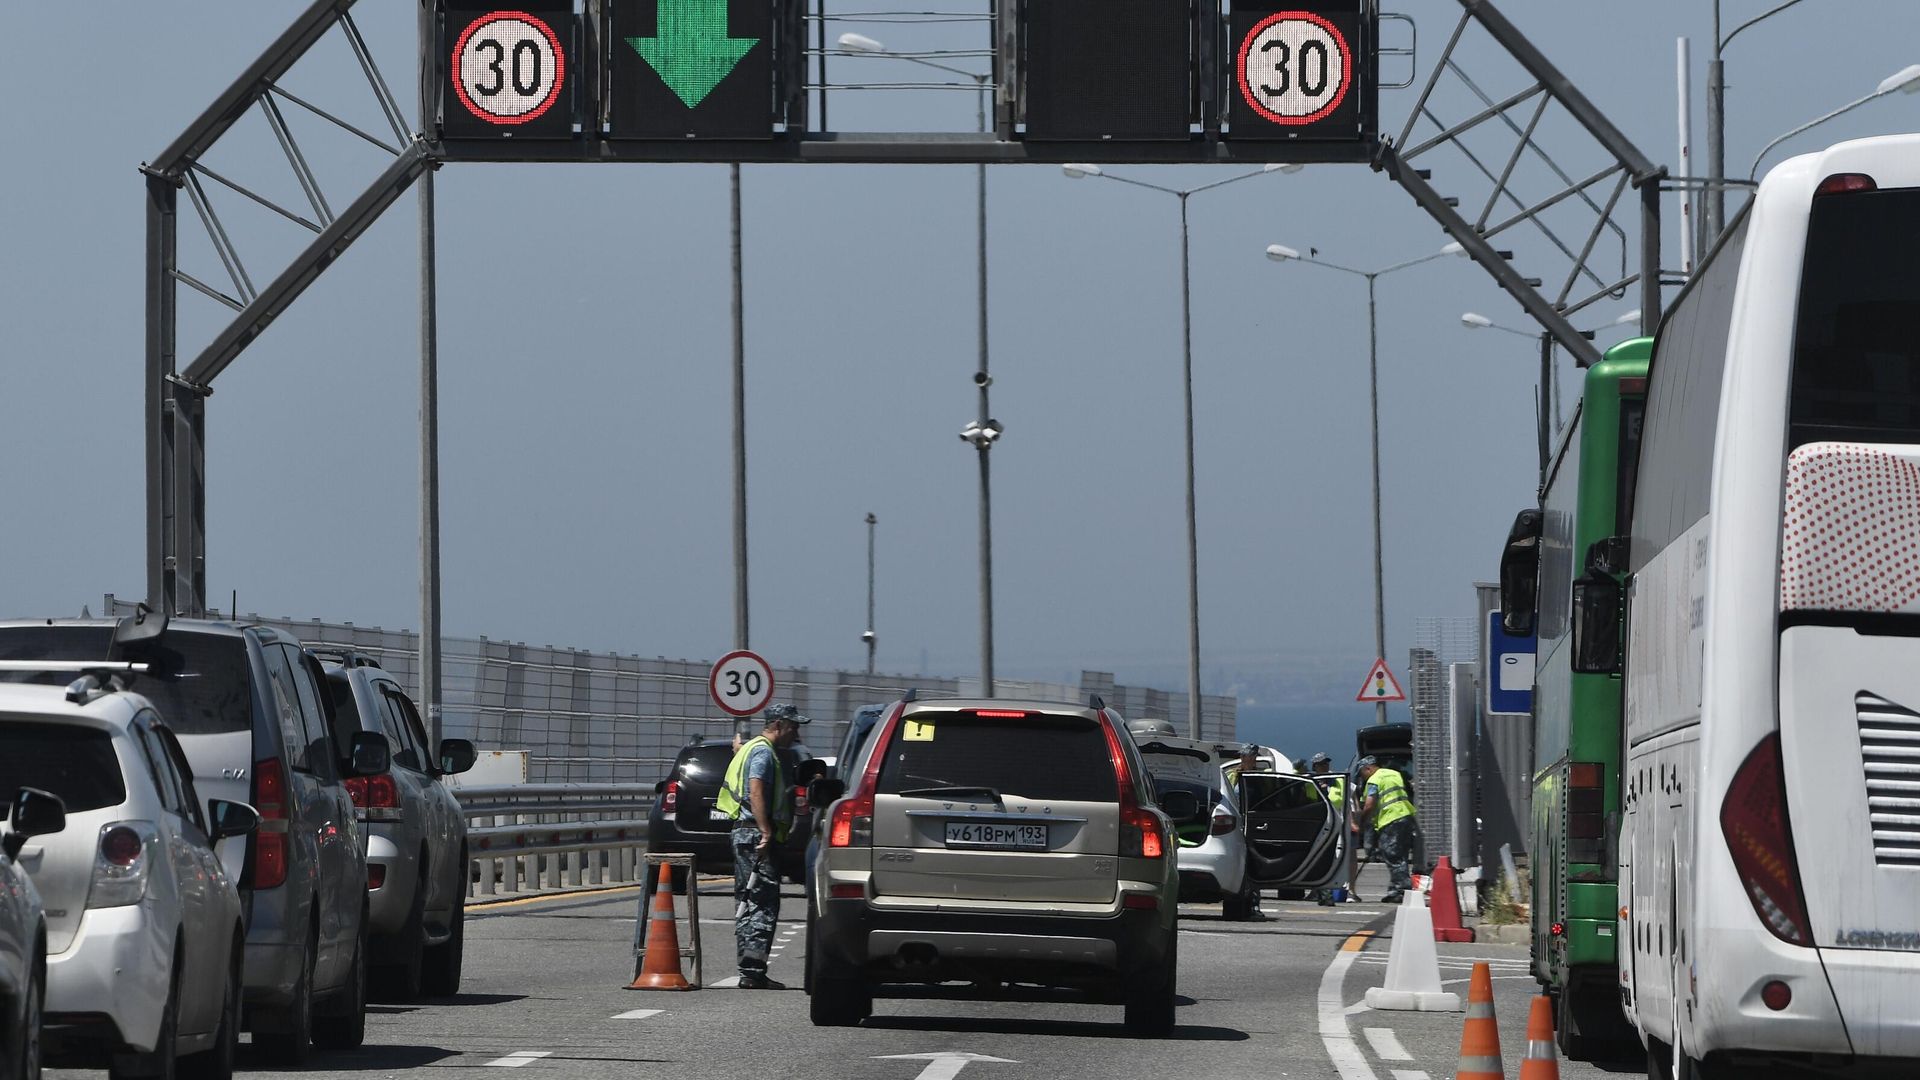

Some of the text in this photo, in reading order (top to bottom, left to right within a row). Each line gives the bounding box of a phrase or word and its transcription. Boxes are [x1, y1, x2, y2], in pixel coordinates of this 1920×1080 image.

[475, 39, 541, 96] 30
[1261, 40, 1327, 96] 30
[725, 670, 761, 697] 30
[1018, 826, 1042, 839] 193
